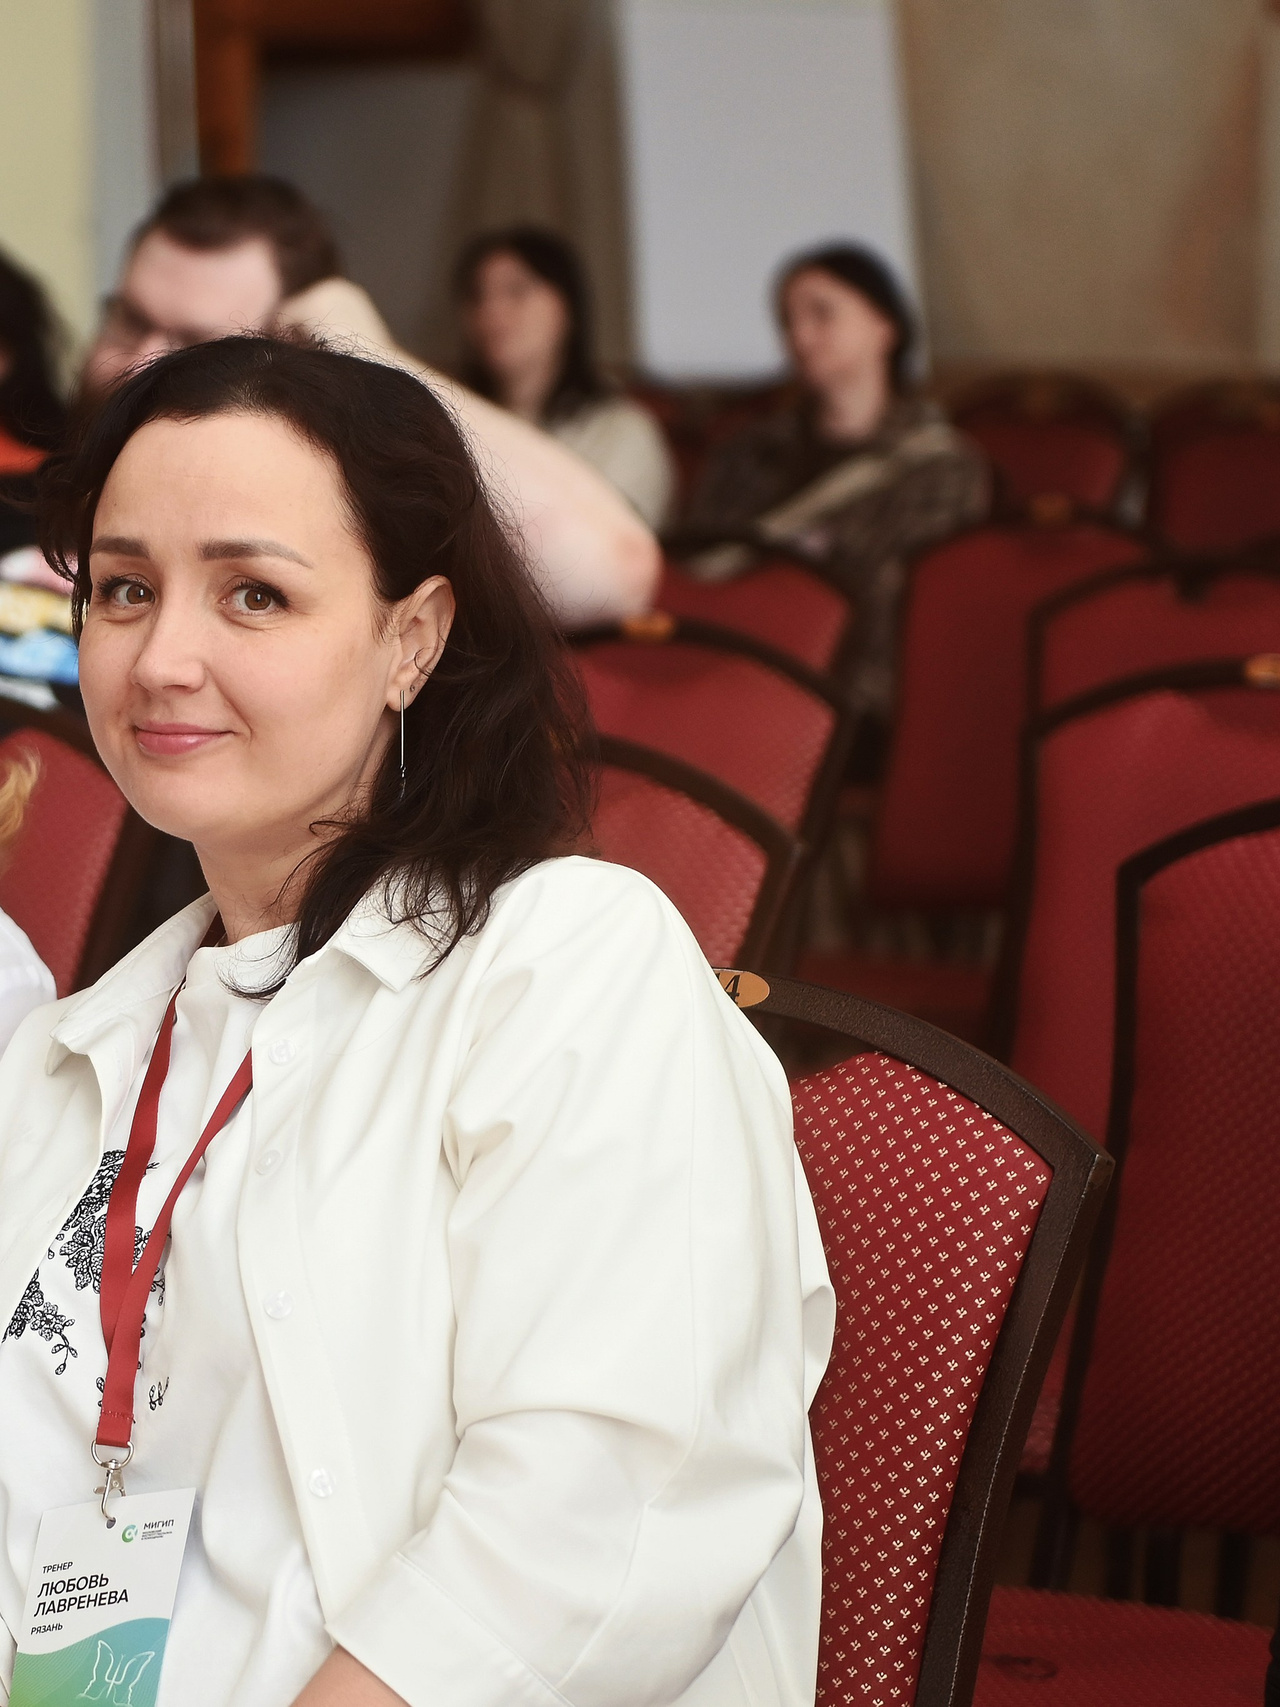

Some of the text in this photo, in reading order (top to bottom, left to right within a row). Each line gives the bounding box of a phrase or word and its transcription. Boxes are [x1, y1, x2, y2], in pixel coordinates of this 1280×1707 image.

[143, 1519, 175, 1530] МИГИП
[42, 1561, 74, 1574] ТРЕНЕР
[37, 1573, 109, 1598] ЛЮБОВЬ
[33, 1589, 129, 1617] ЛАВРЕНЕВА
[30, 1621, 64, 1635] РЯЗАНЬ
